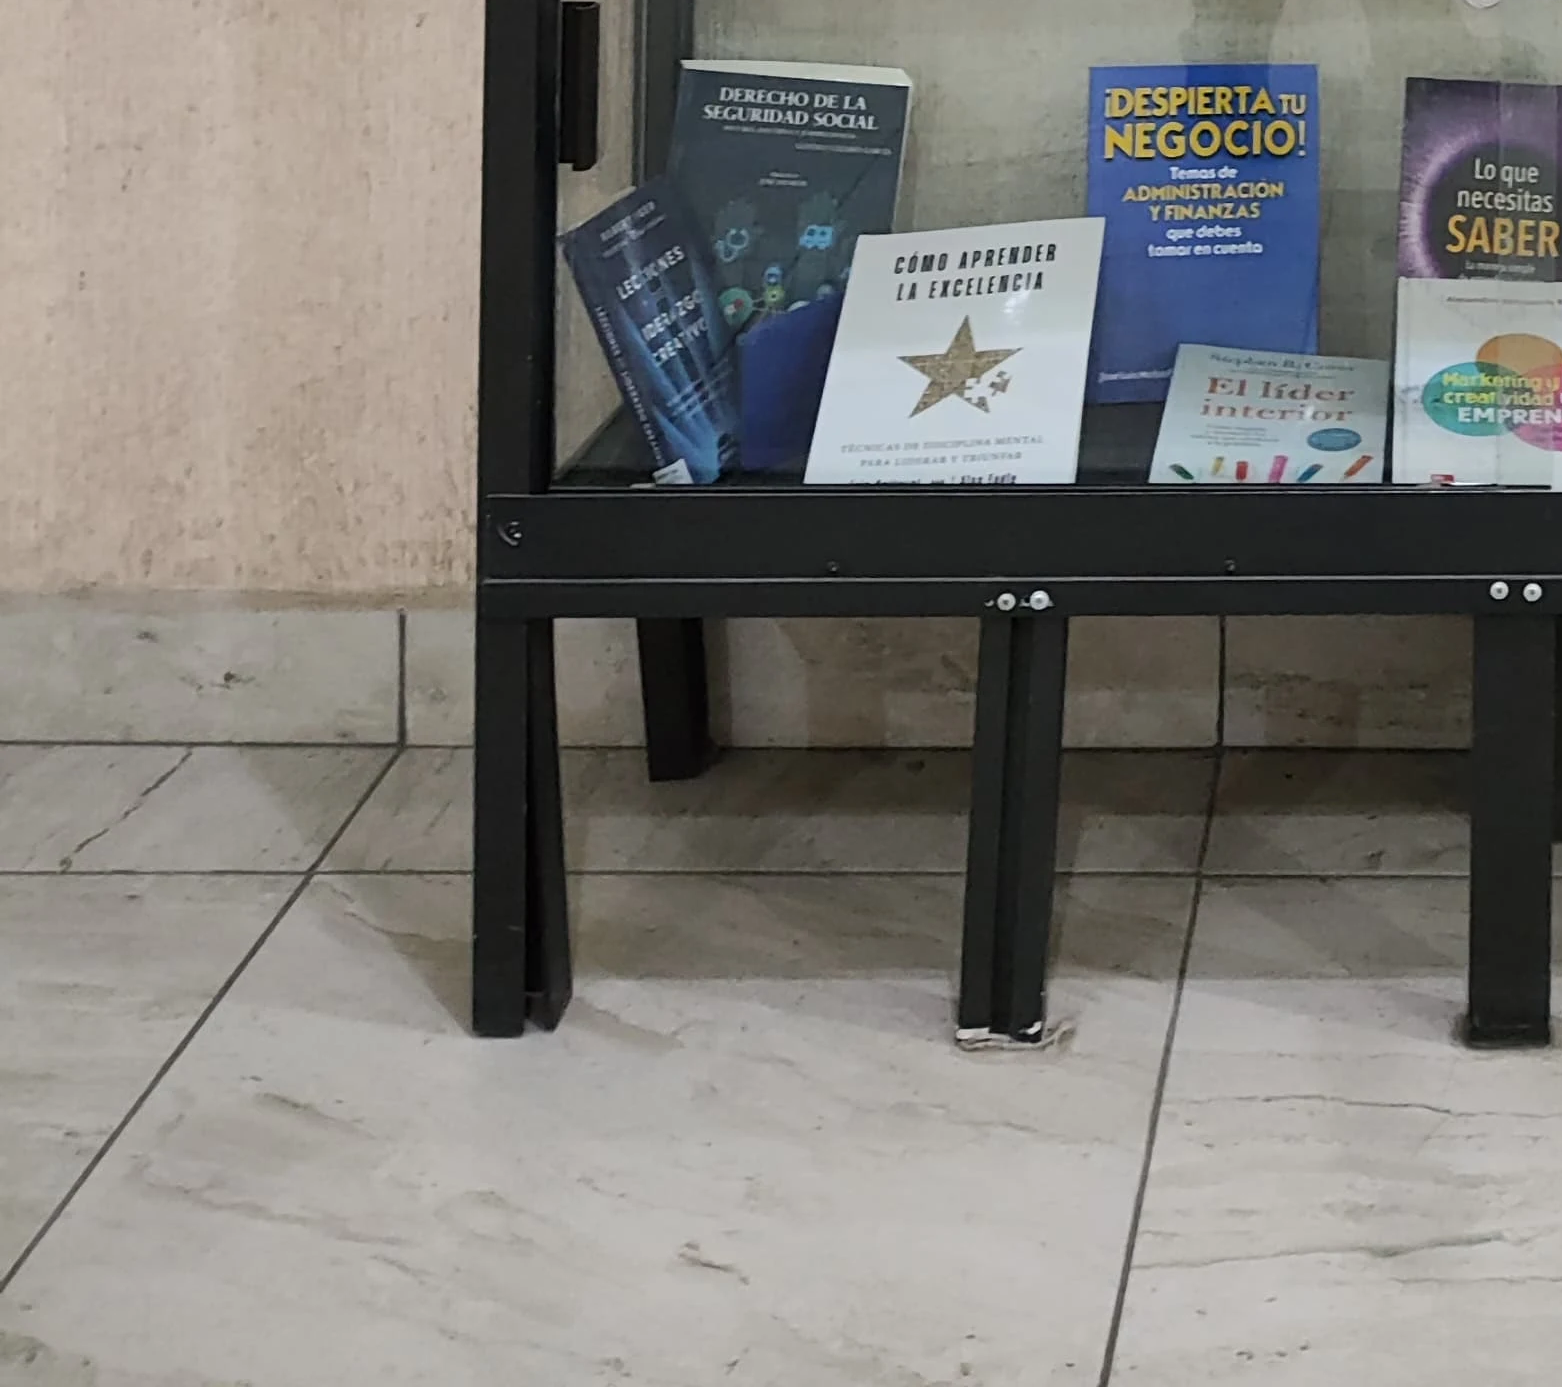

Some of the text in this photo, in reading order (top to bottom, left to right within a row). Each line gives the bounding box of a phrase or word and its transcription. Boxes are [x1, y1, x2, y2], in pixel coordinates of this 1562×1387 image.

[719, 86, 868, 111] DERECHO DE LA
[1278, 93, 1306, 115] TU
[702, 104, 880, 131] SEGURIDAD SOCIAL
[1103, 119, 1307, 160] NEGOCIO!
[1169, 165, 1239, 180] Temas de
[1474, 157, 1540, 188] Lo que
[1121, 178, 1285, 202] ADMINISTRACIÓN
[1456, 188, 1554, 213] necesitas
[1149, 202, 1261, 221] Y FINANZAS
[1165, 224, 1242, 242] que debes
[1445, 213, 1561, 258] SABER
[894, 243, 1057, 275] CÓMO APRENDER
[1147, 241, 1264, 257] tomar en cuenta
[896, 271, 1045, 301] LA EXCELENCIA
[1207, 376, 1355, 402] El líder
[1442, 372, 1562, 393] Marketing y
[1199, 397, 1354, 422] interior
[1442, 391, 1555, 405] creatvidad
